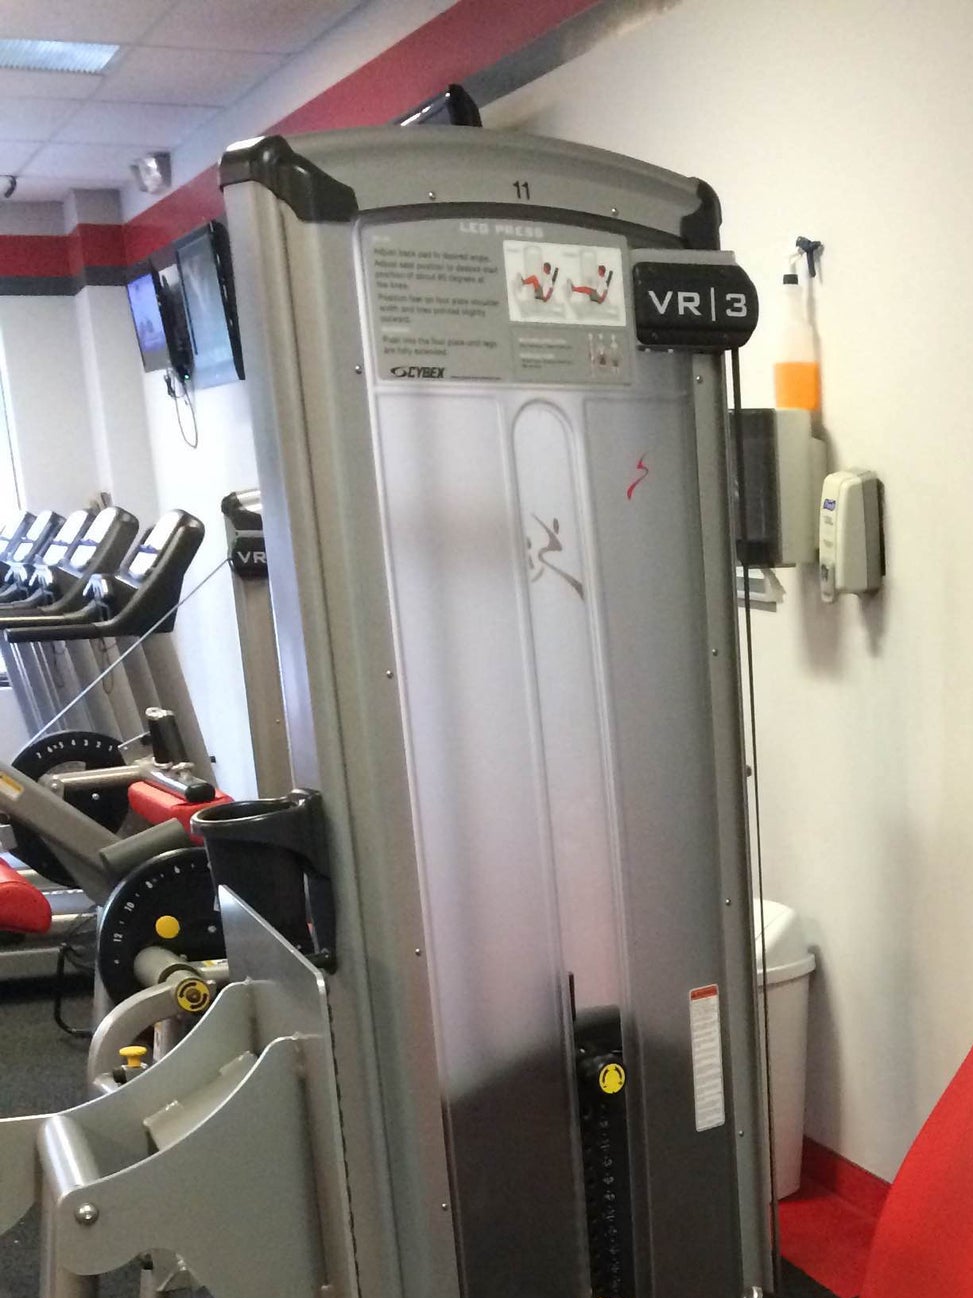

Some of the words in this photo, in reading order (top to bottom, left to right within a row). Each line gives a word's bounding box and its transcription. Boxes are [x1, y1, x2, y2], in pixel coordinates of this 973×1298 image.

[513, 180, 530, 200] 11
[495, 224, 544, 238] PRESS
[406, 366, 446, 379] CYBEX
